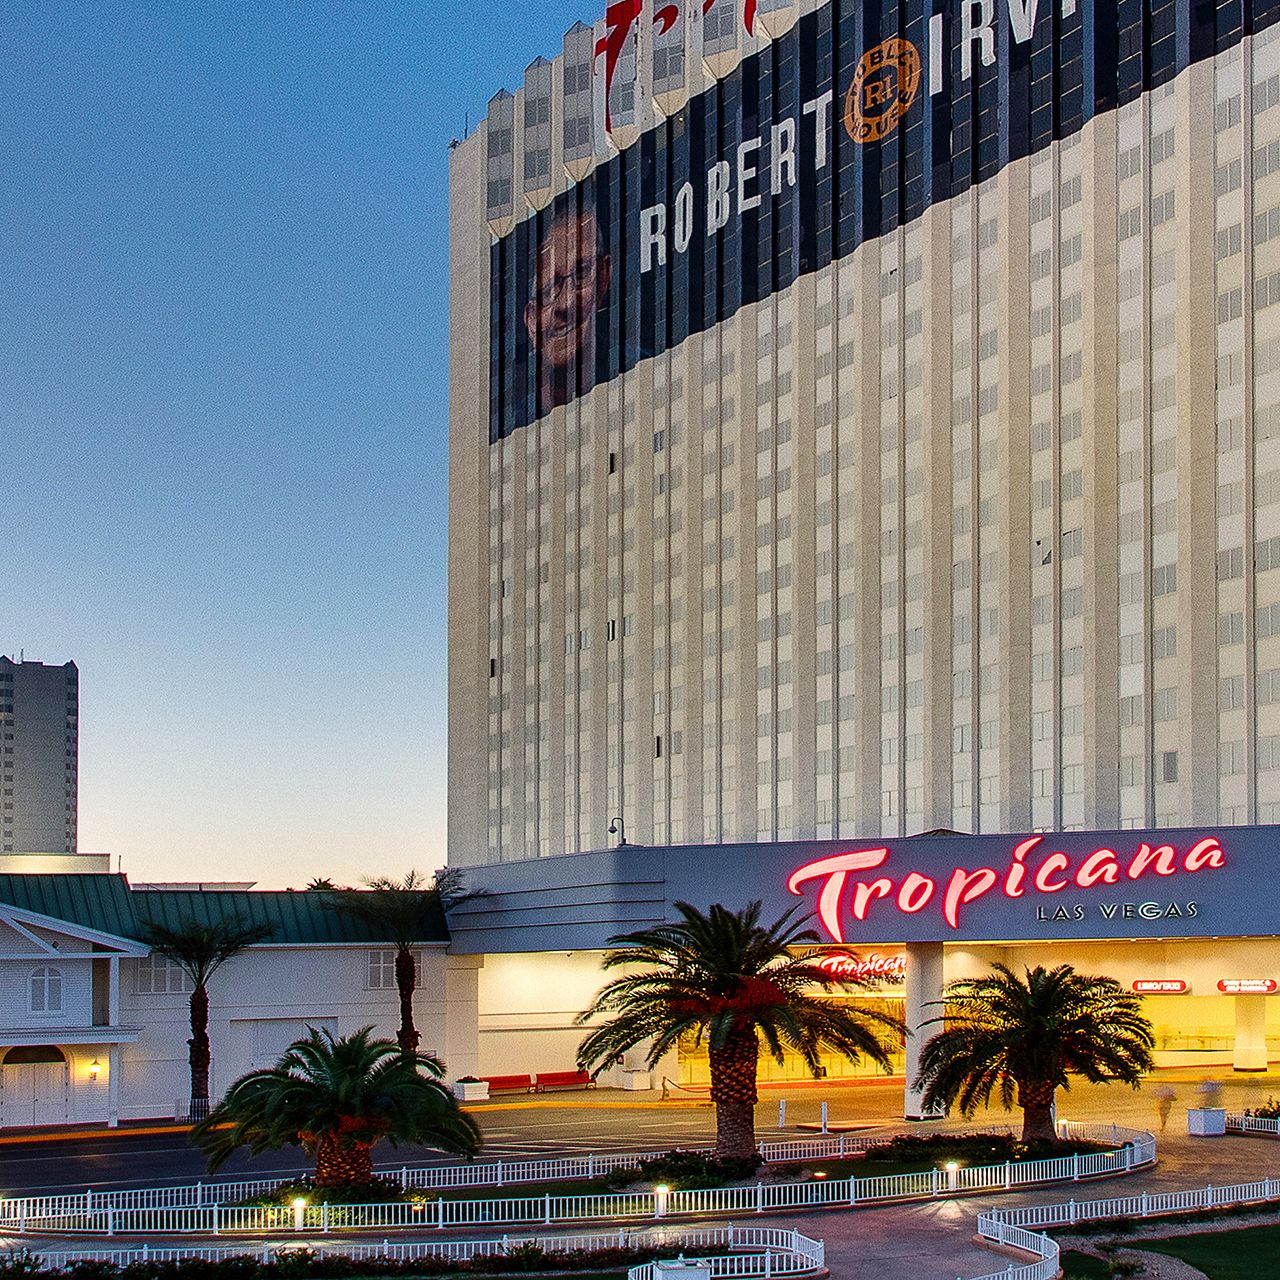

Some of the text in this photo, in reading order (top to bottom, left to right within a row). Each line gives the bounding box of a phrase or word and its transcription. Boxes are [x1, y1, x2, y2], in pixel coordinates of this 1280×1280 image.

[863, 74, 893, 110] RI
[639, 89, 838, 274] ROBERT
[787, 835, 1227, 944] Tropicana
[1037, 901, 1199, 922] LAS VEGAS
[1137, 981, 1181, 991] LIMO/TAXI
